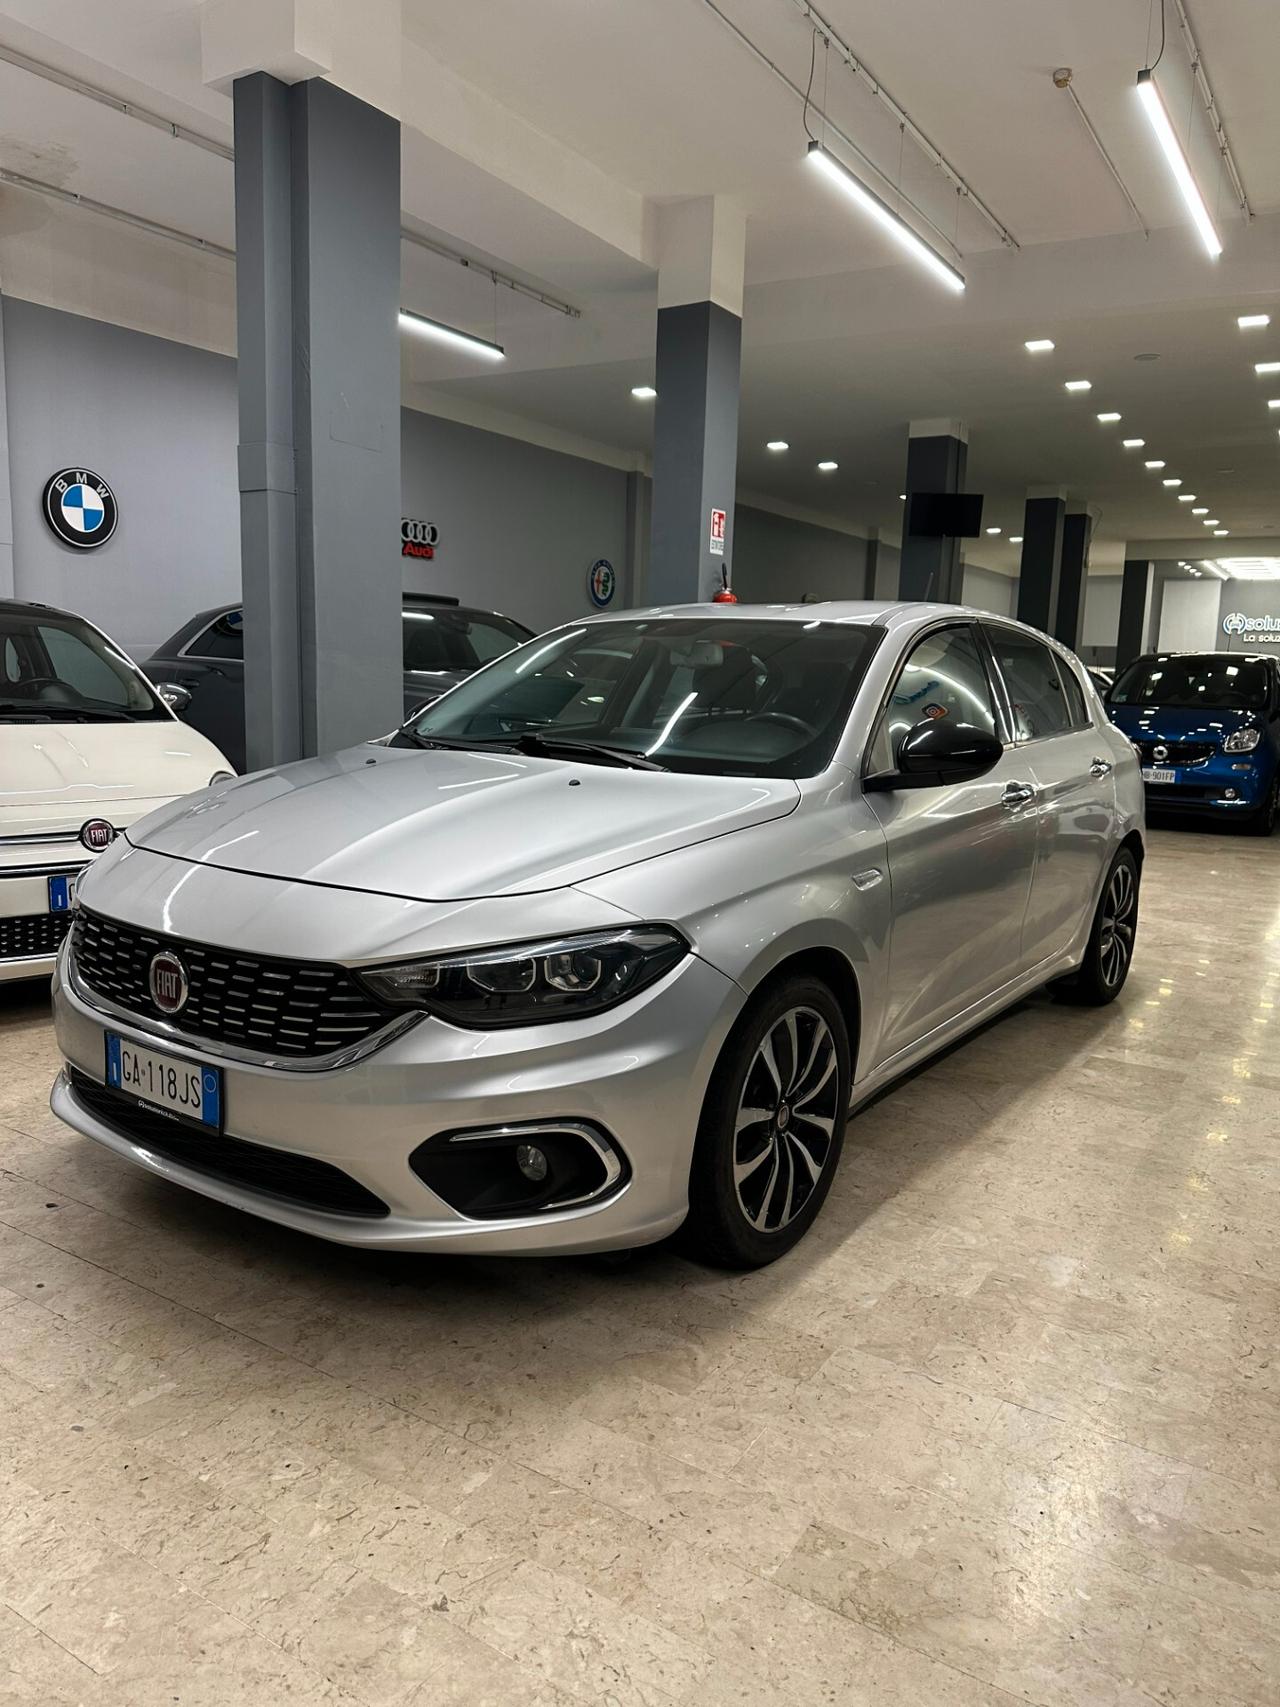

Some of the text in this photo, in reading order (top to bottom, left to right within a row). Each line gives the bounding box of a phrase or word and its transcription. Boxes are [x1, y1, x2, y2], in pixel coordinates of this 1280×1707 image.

[55, 472, 110, 499] BMW
[91, 829, 108, 843] FIAT
[157, 969, 178, 999] FIAT
